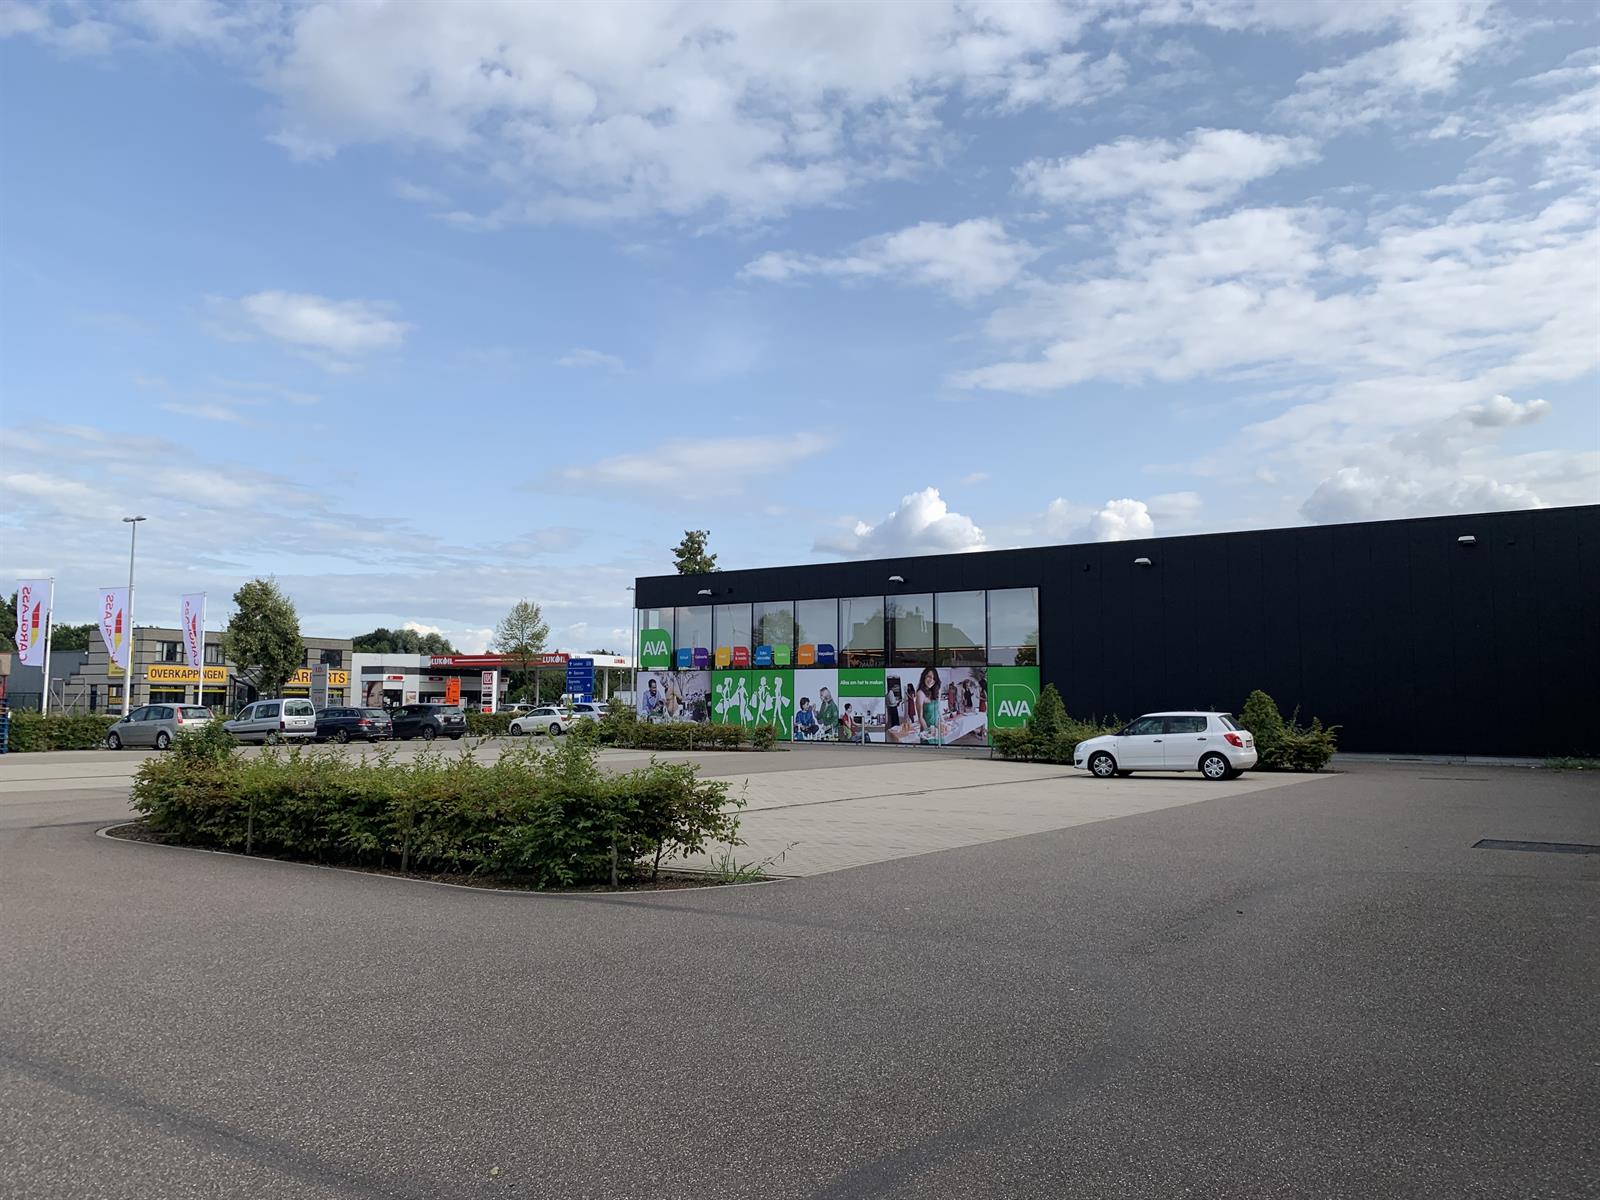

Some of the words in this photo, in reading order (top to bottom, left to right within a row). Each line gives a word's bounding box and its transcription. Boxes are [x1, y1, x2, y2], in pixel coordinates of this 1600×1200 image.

[643, 641, 668, 656] AVA
[431, 657, 453, 665] LUKOIL
[542, 655, 566, 664] LUKOIL
[150, 668, 224, 679] OVERKAPPINGEN
[998, 700, 1032, 717] AVA
